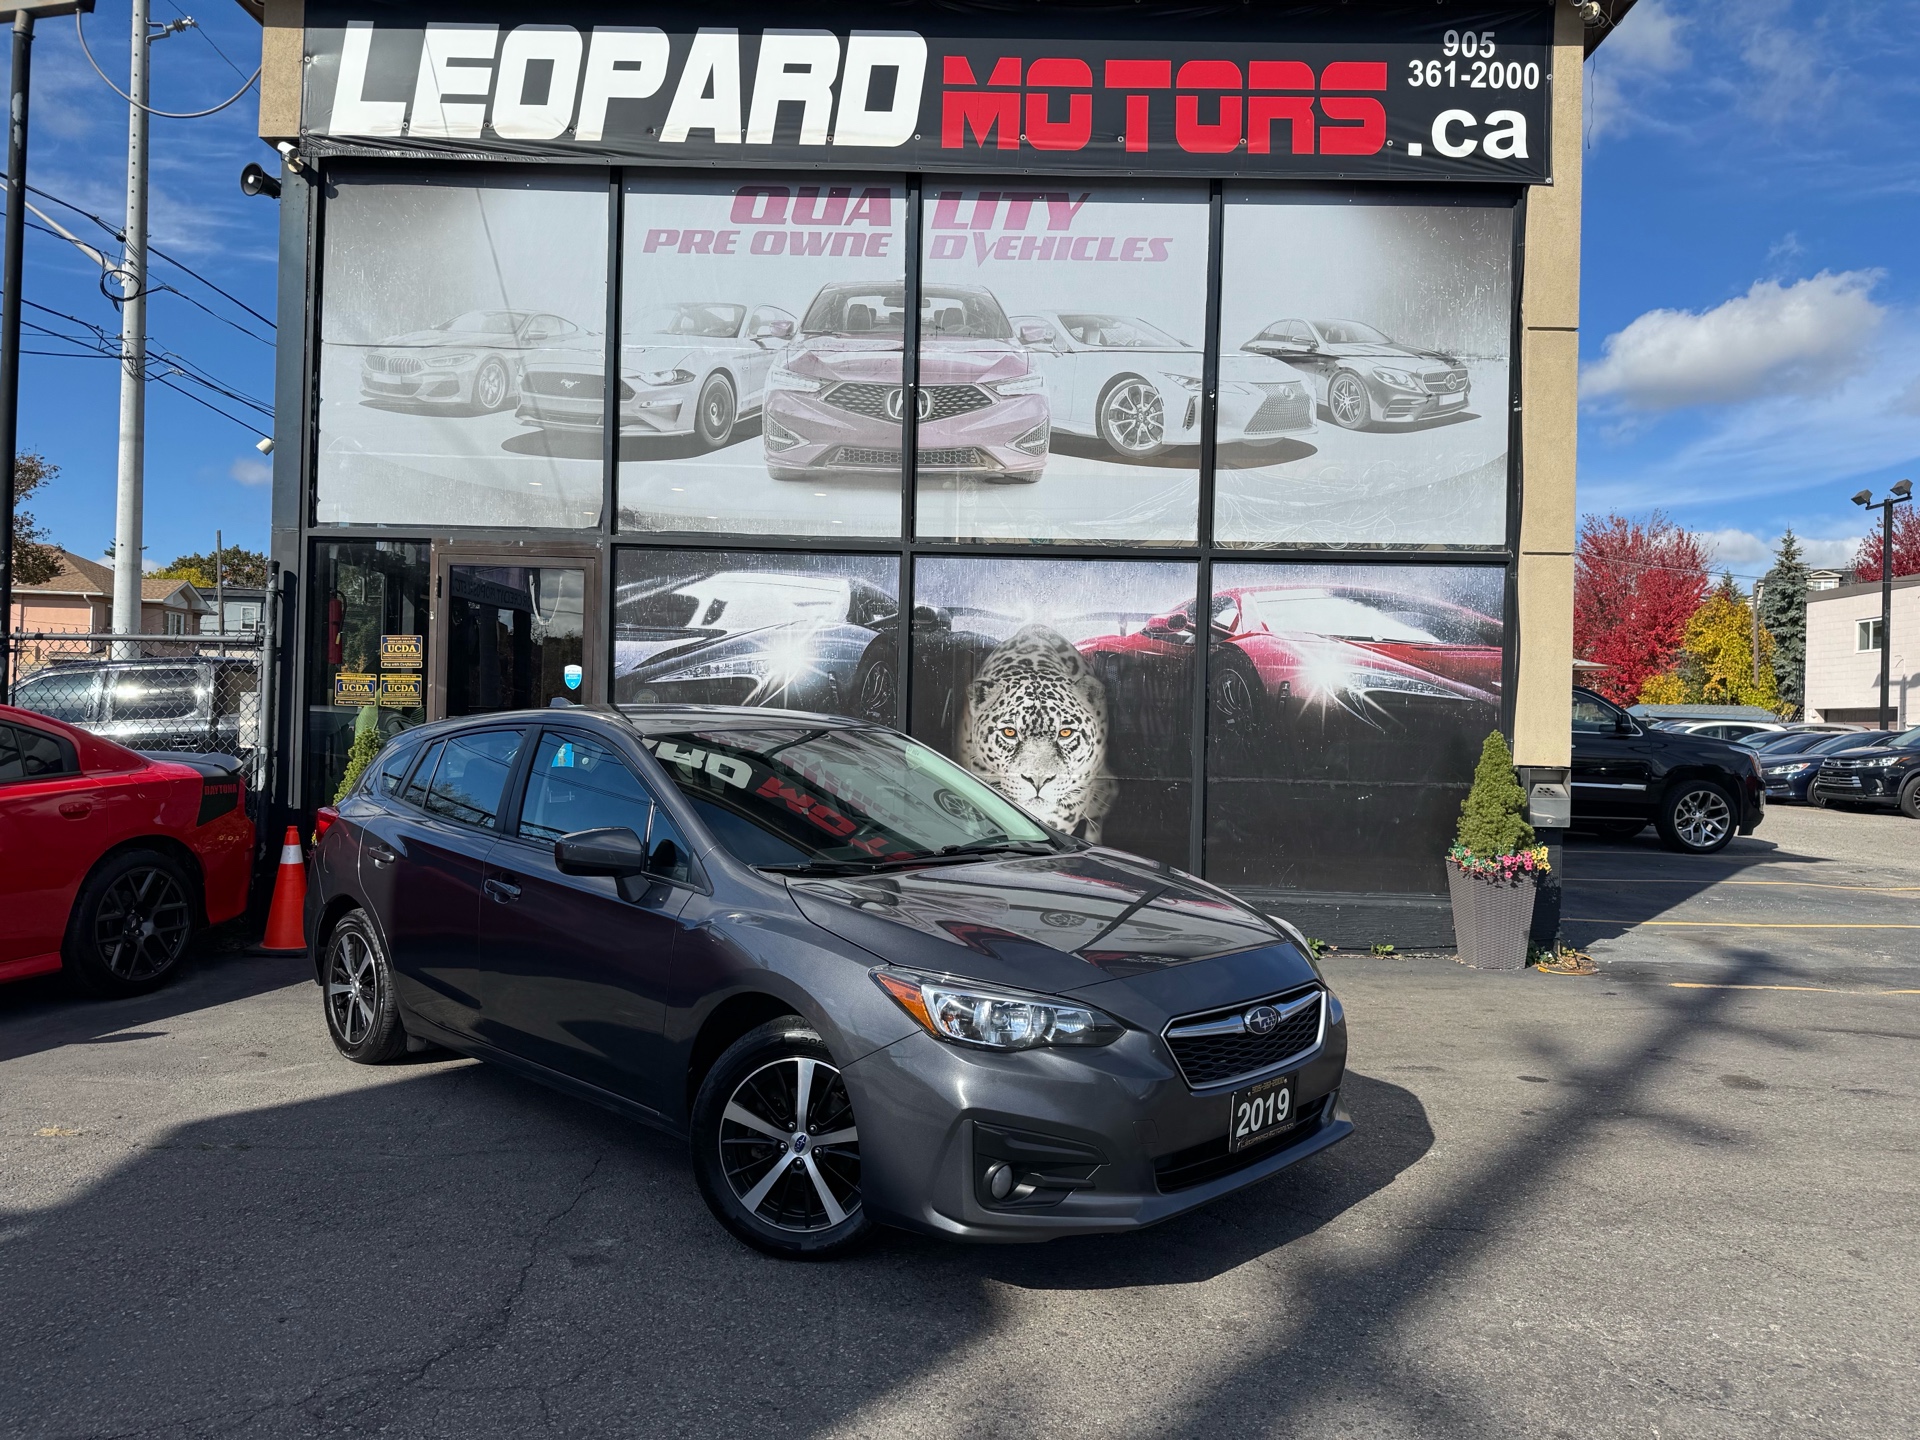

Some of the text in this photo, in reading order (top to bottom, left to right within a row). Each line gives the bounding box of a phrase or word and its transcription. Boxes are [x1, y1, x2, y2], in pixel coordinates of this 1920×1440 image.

[1443, 29, 1496, 58] 905
[329, 21, 1387, 155] LEOPARD MOTORS
[1407, 59, 1540, 90] 361-2000
[1407, 109, 1529, 159] .ca
[643, 229, 741, 255] PRE
[387, 644, 417, 653] UCDA
[342, 683, 370, 692] UCDA
[387, 684, 415, 692] UCDA
[204, 784, 237, 795] DAYTONA
[1235, 1087, 1290, 1138] 2019
